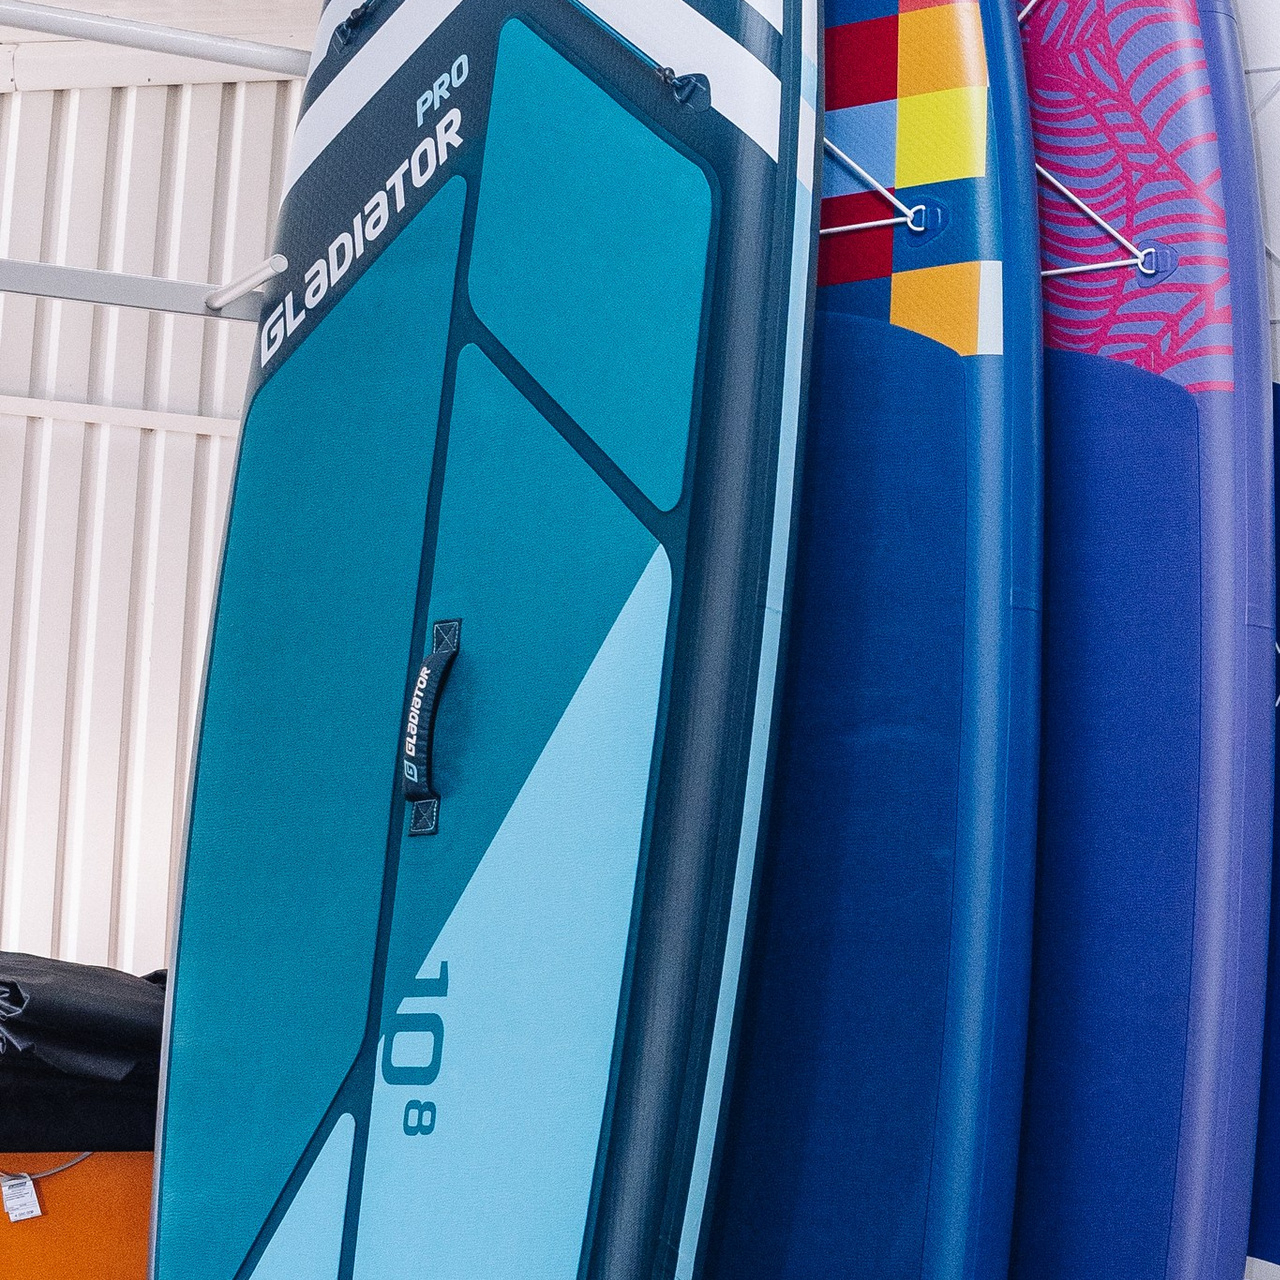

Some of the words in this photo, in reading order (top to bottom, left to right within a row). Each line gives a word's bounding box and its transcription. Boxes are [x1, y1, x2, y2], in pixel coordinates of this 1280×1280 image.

[260, 108, 465, 368] GLADIATOR
[416, 53, 470, 128] PRO
[406, 666, 431, 757] GLADIATOR
